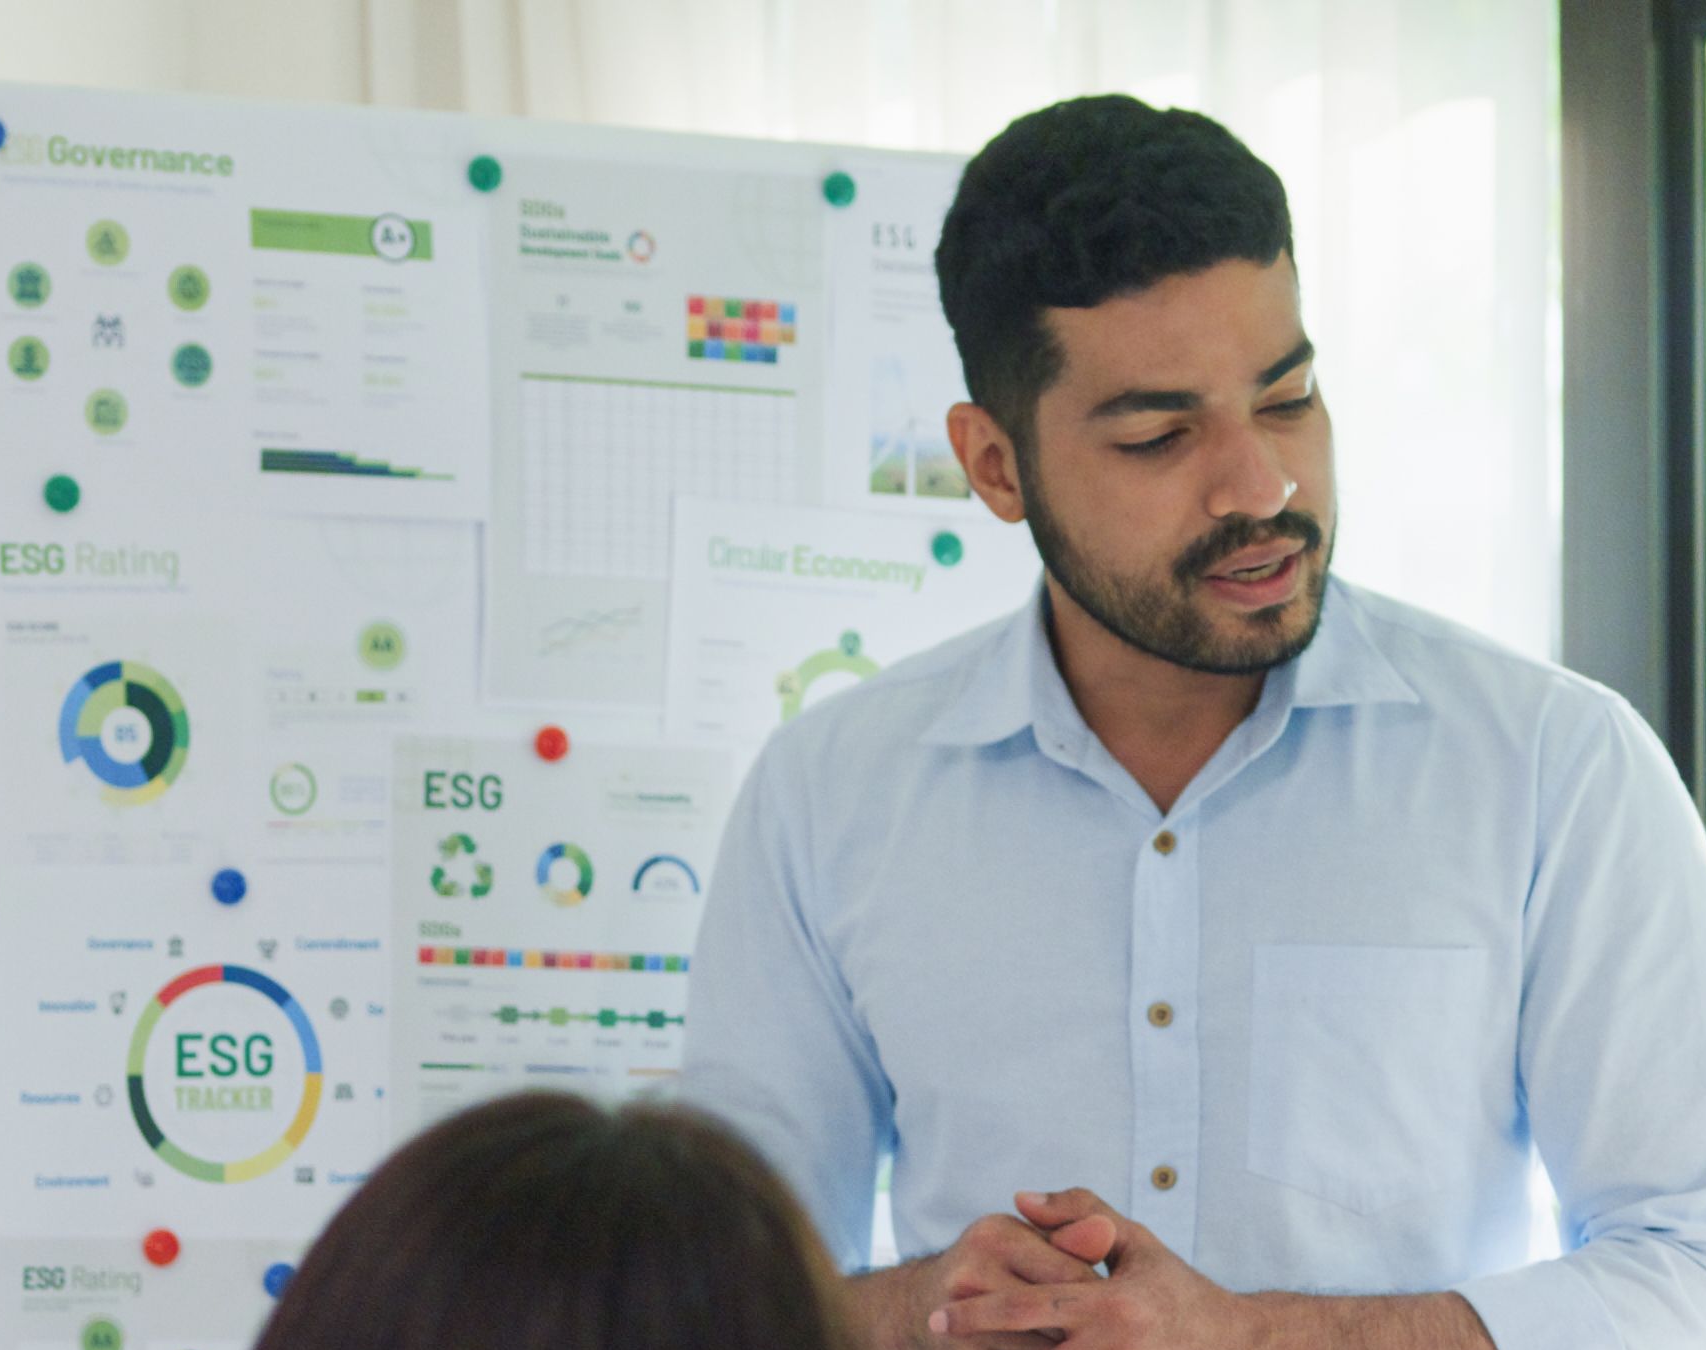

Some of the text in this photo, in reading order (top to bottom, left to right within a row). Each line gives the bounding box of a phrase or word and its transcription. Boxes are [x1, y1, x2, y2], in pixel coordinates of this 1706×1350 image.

[47, 134, 234, 177] Governance
[0, 539, 180, 588] ESG Rating
[792, 545, 927, 593] Economy
[424, 771, 503, 810] ESG
[175, 1033, 274, 1078] ESG
[174, 1086, 274, 1111] TRACKER
[22, 1266, 142, 1297] ESG Rating
